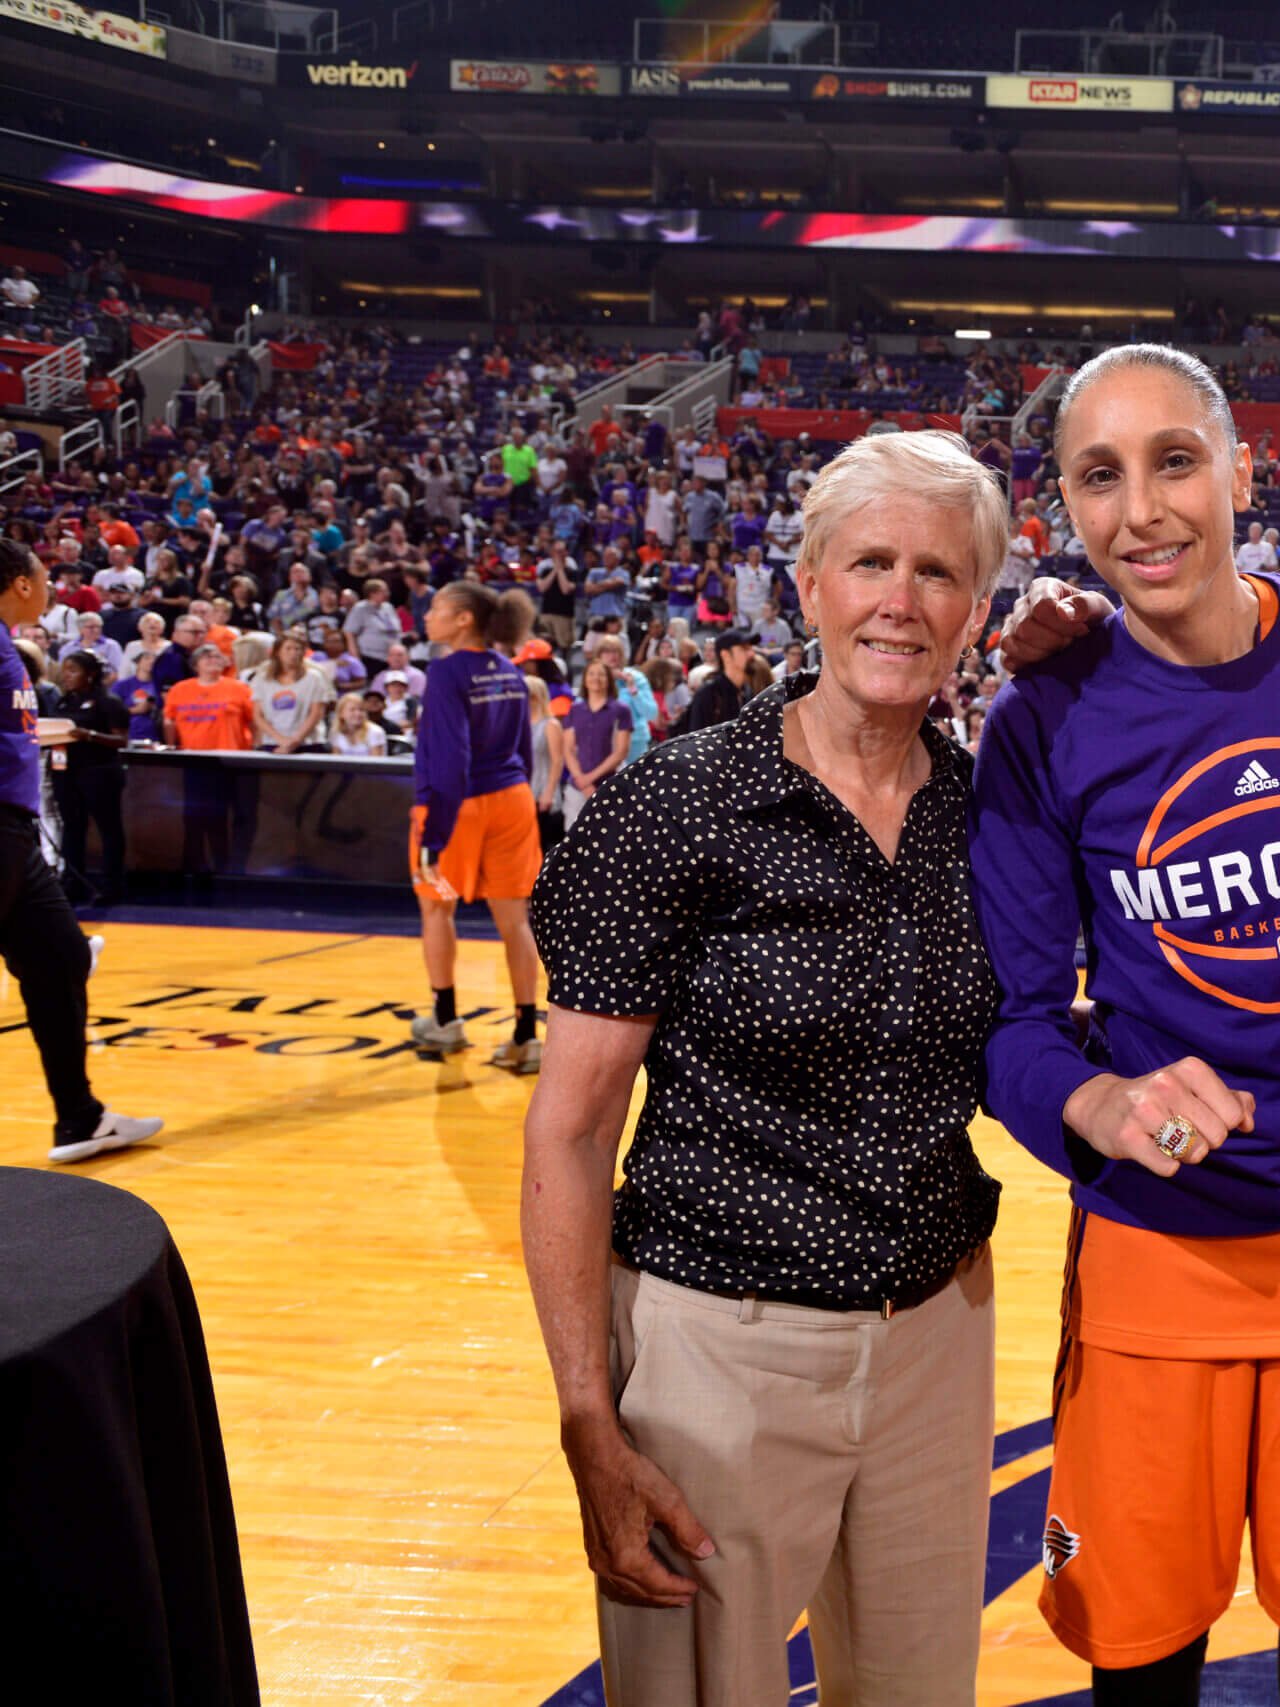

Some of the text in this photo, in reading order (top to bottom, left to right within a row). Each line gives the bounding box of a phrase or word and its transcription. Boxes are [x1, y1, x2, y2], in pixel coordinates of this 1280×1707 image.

[307, 60, 407, 88] verizon
[1031, 82, 1132, 101] KTAR NEWS
[1203, 90, 1280, 106] REPUBLIC
[1233, 778, 1280, 797] adidas
